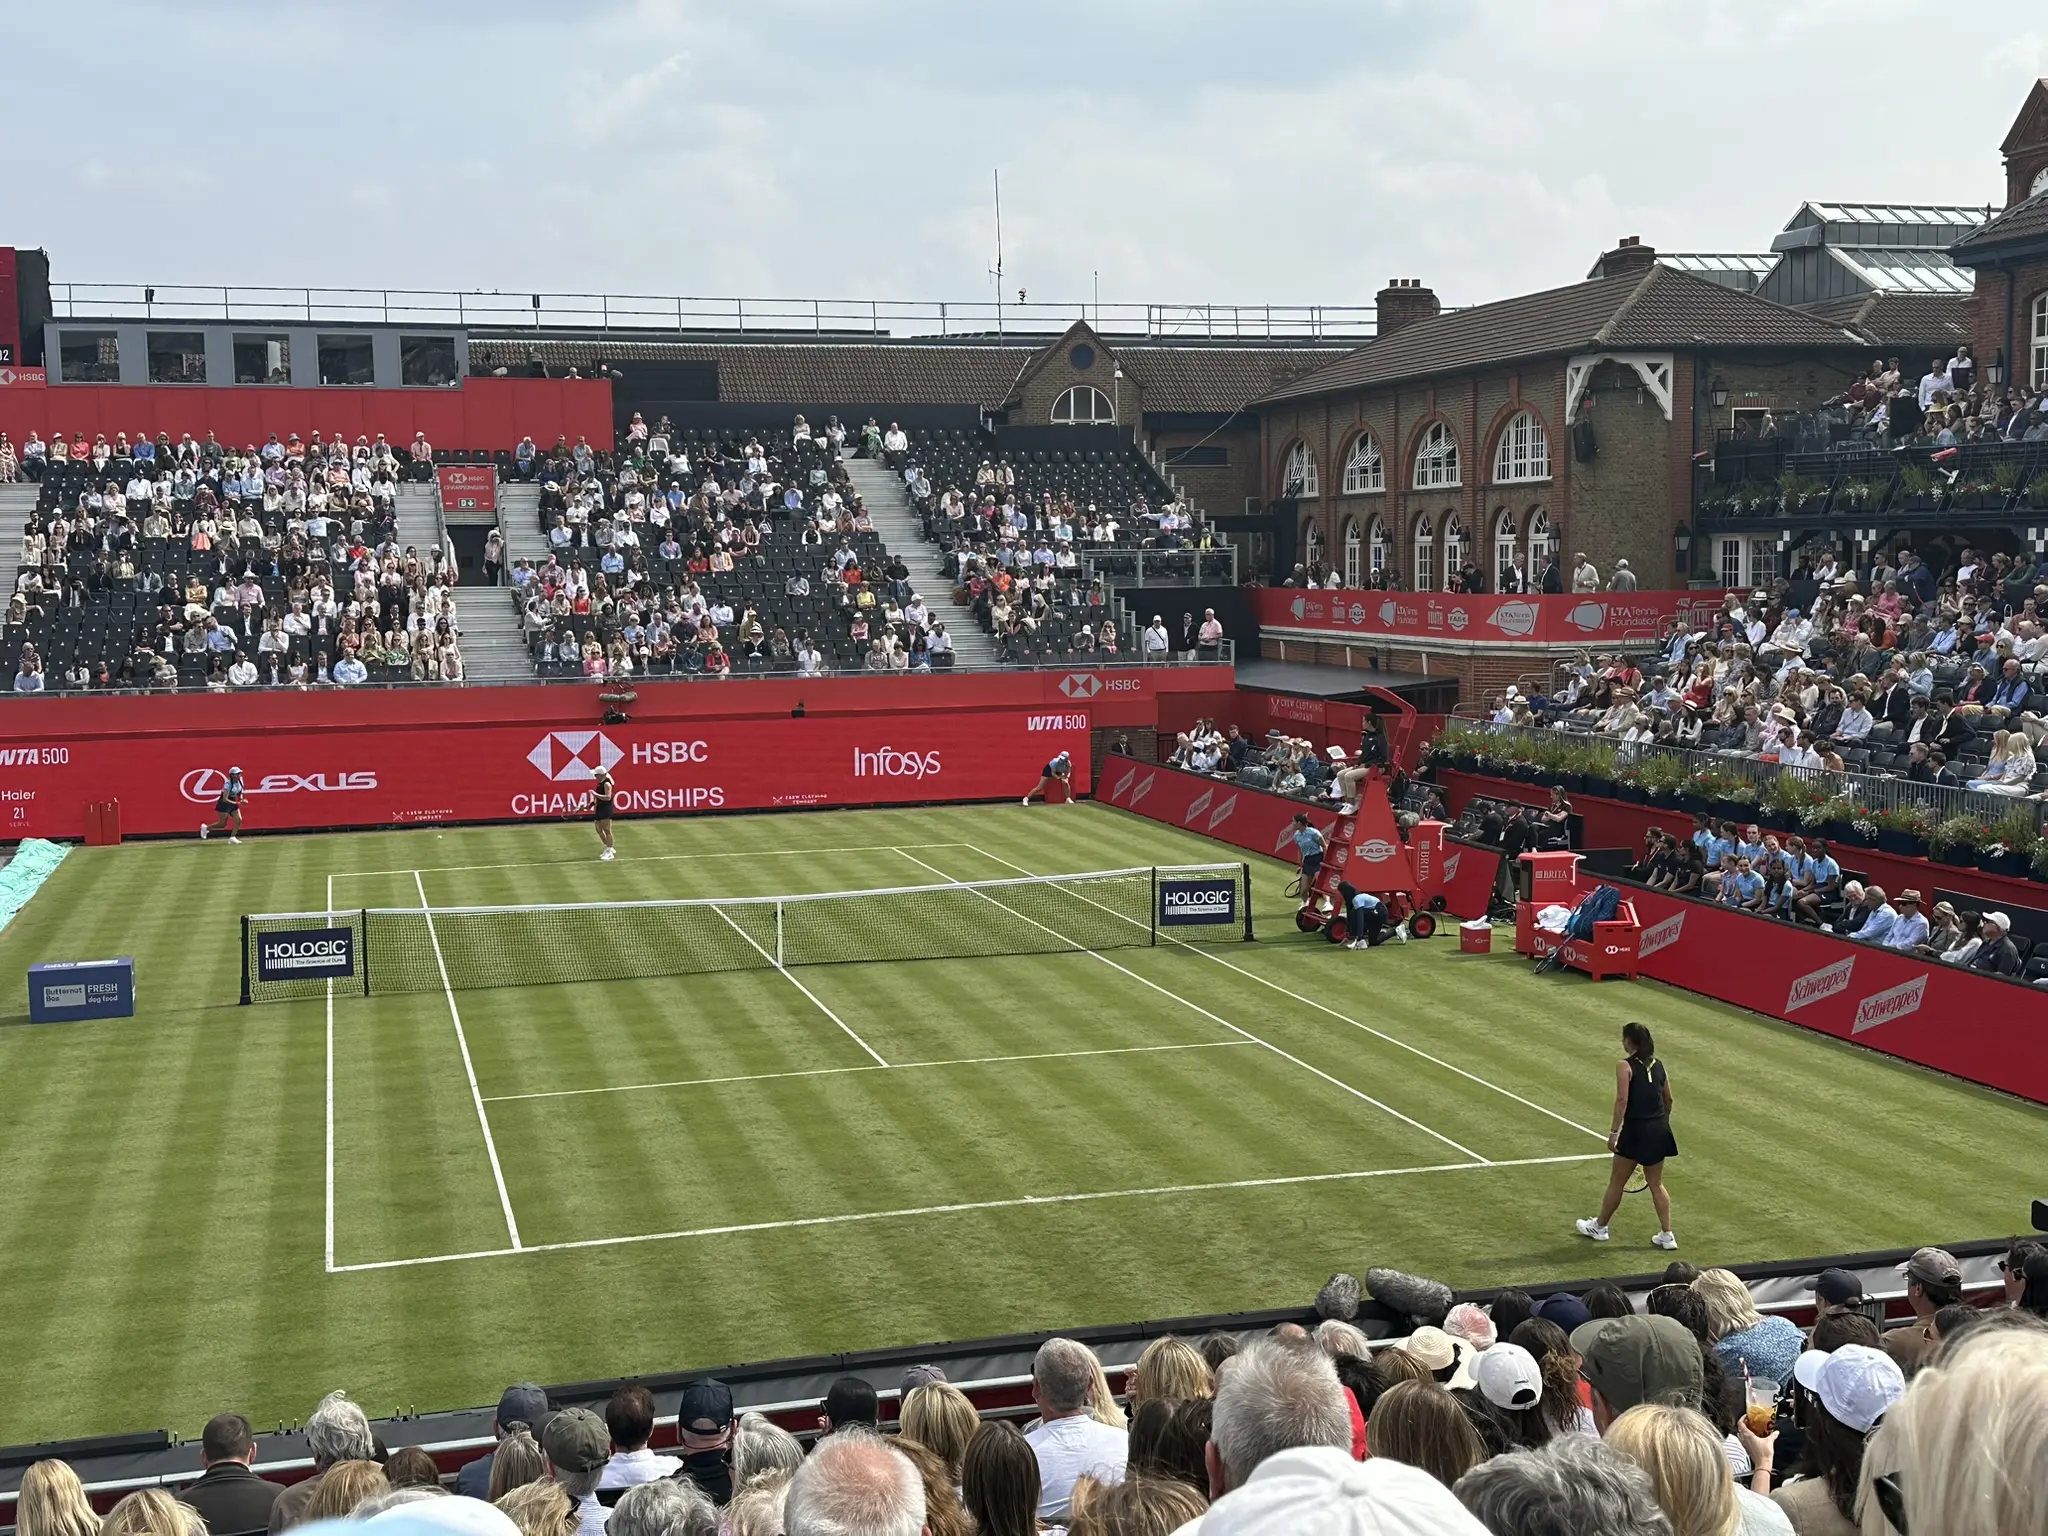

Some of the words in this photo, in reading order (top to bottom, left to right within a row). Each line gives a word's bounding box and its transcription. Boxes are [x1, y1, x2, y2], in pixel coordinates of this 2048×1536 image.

[19, 373, 45, 381] HSBC
[1611, 607, 1631, 617] LTA
[1631, 606, 1658, 615] Tennis
[1611, 617, 1659, 626] Foundation
[1105, 679, 1140, 691] HSBC
[1027, 715, 1063, 731] WTA
[1065, 714, 1086, 729] 500
[42, 747, 68, 765] 500
[632, 740, 708, 765] HSBC
[854, 746, 941, 780] Infosys
[1, 789, 36, 801] Haier
[511, 786, 724, 815] CHAMONSHIPS
[13, 807, 24, 819] 21
[1359, 846, 1393, 854] FAGE
[1420, 851, 1429, 882] BRITA
[1543, 870, 1568, 879] BRITA
[1165, 890, 1230, 905] HOLOGIC
[265, 940, 346, 958] HOLOGIC
[87, 983, 118, 993] FRESH
[1791, 965, 1851, 1003] Schweppes
[45, 987, 83, 996] Butternut
[87, 996, 102, 1004] dog
[1858, 987, 1920, 1023] Schweppes
